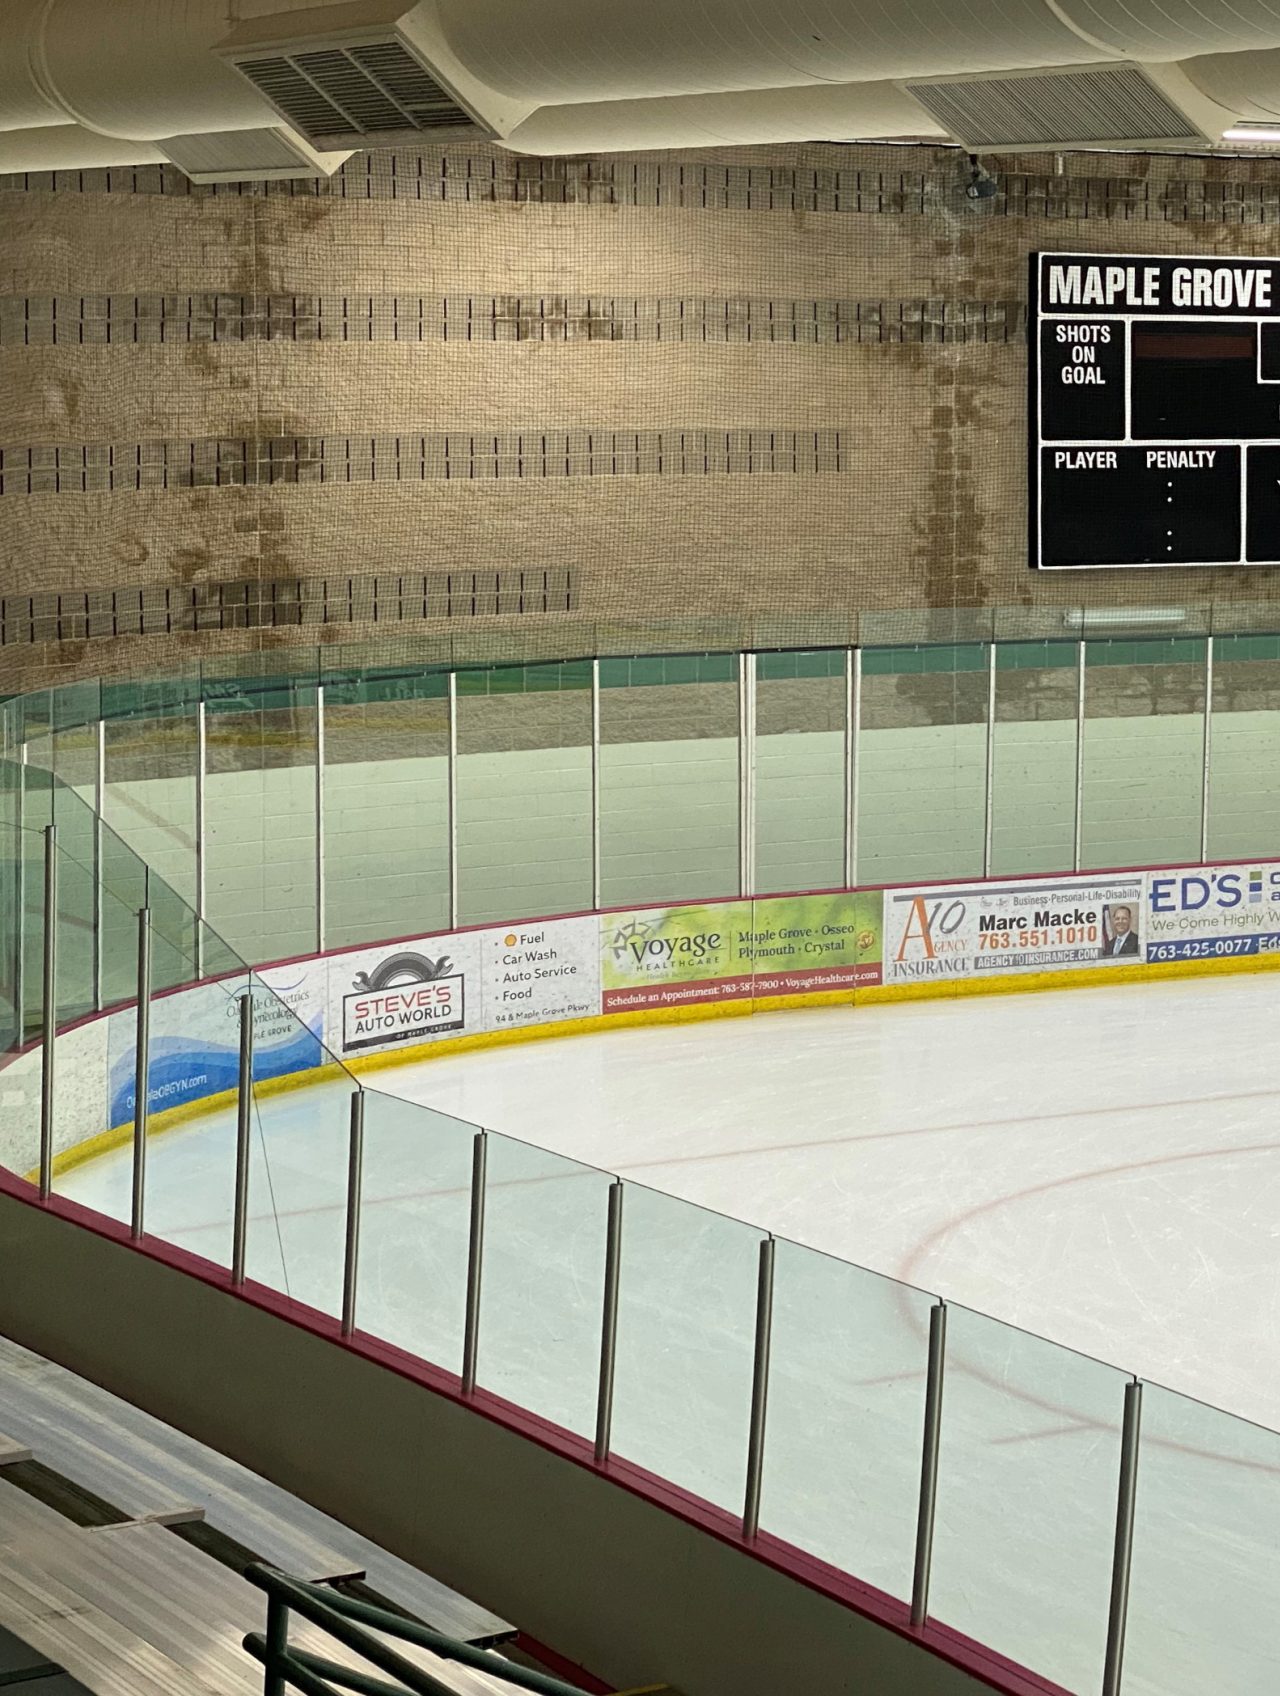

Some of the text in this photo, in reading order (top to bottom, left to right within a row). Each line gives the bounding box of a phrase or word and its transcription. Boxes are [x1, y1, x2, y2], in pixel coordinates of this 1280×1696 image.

[1049, 264, 1162, 307] MAPLE
[1171, 267, 1272, 309] GROVE
[1056, 324, 1111, 344] SHOTS
[1072, 345, 1096, 365] ON
[1061, 365, 1106, 386] GOAL
[1054, 450, 1217, 471] PLAYER PENALTY
[1149, 874, 1243, 913] ED'S
[979, 908, 1097, 932] Marc Macke
[1152, 919, 1177, 931] We
[1179, 915, 1219, 930] Come
[1223, 912, 1264, 929] Highly
[520, 932, 545, 945] Fuel
[739, 922, 855, 943] Maple Grove Osseo
[979, 925, 1098, 951] 763.551.1010
[502, 949, 557, 966] Car Wash
[630, 932, 721, 964] Voyage
[739, 938, 845, 960] Plymouth Crystal
[1149, 938, 1252, 961] 763-425-0077
[502, 965, 577, 984] Auto Service
[636, 956, 720, 972] HEALTHCARE
[502, 988, 532, 1001] Food
[607, 970, 879, 1008] Schedule an Appointment: 763-587-7900 VoyageHealthcare.com
[355, 985, 451, 1019] STEVE'S
[516, 1010, 539, 1019] Maple
[542, 1007, 565, 1015] Grove
[567, 1004, 590, 1012] Pkwy
[355, 1004, 451, 1034] AUTO WORLD
